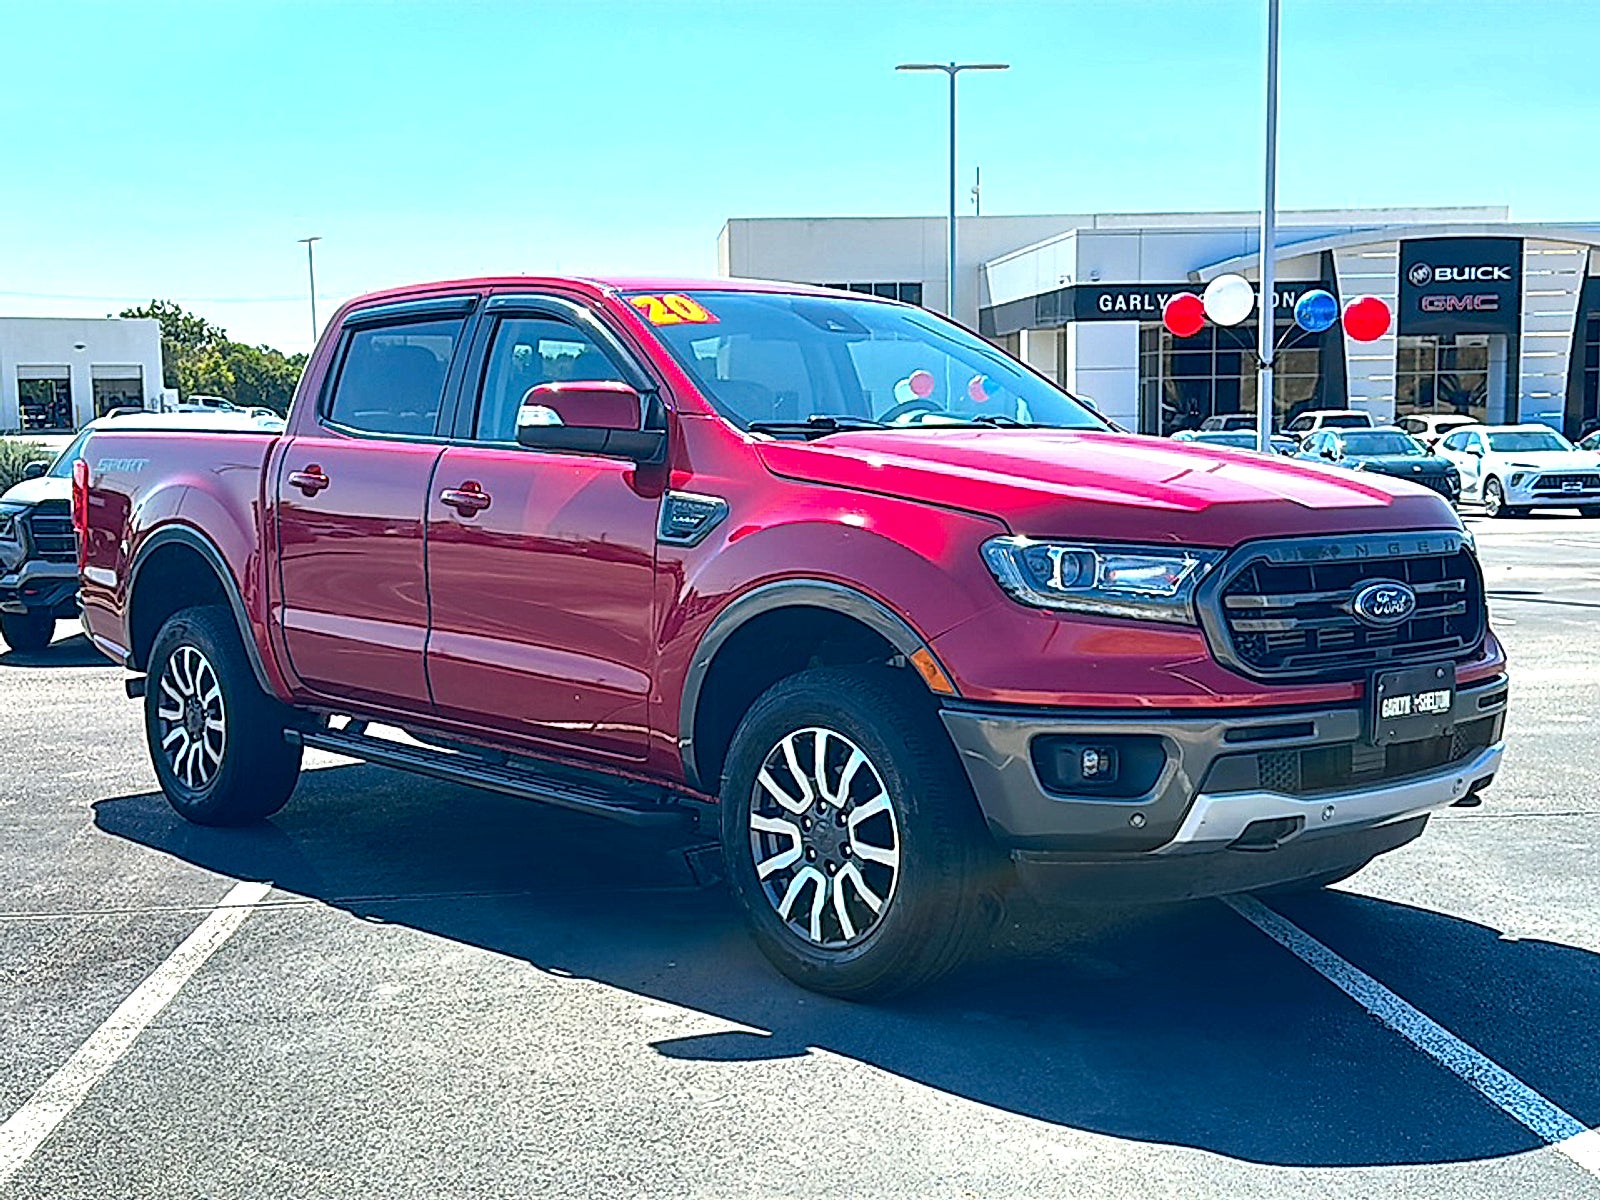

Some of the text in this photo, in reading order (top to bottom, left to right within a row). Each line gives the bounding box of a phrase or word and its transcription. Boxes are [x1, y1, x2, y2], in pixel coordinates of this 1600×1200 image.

[1434, 266, 1512, 281] BUICK
[629, 293, 709, 325] 20
[1099, 294, 1174, 311] GARLY
[1421, 294, 1499, 311] GMC
[1373, 590, 1407, 615] Ford
